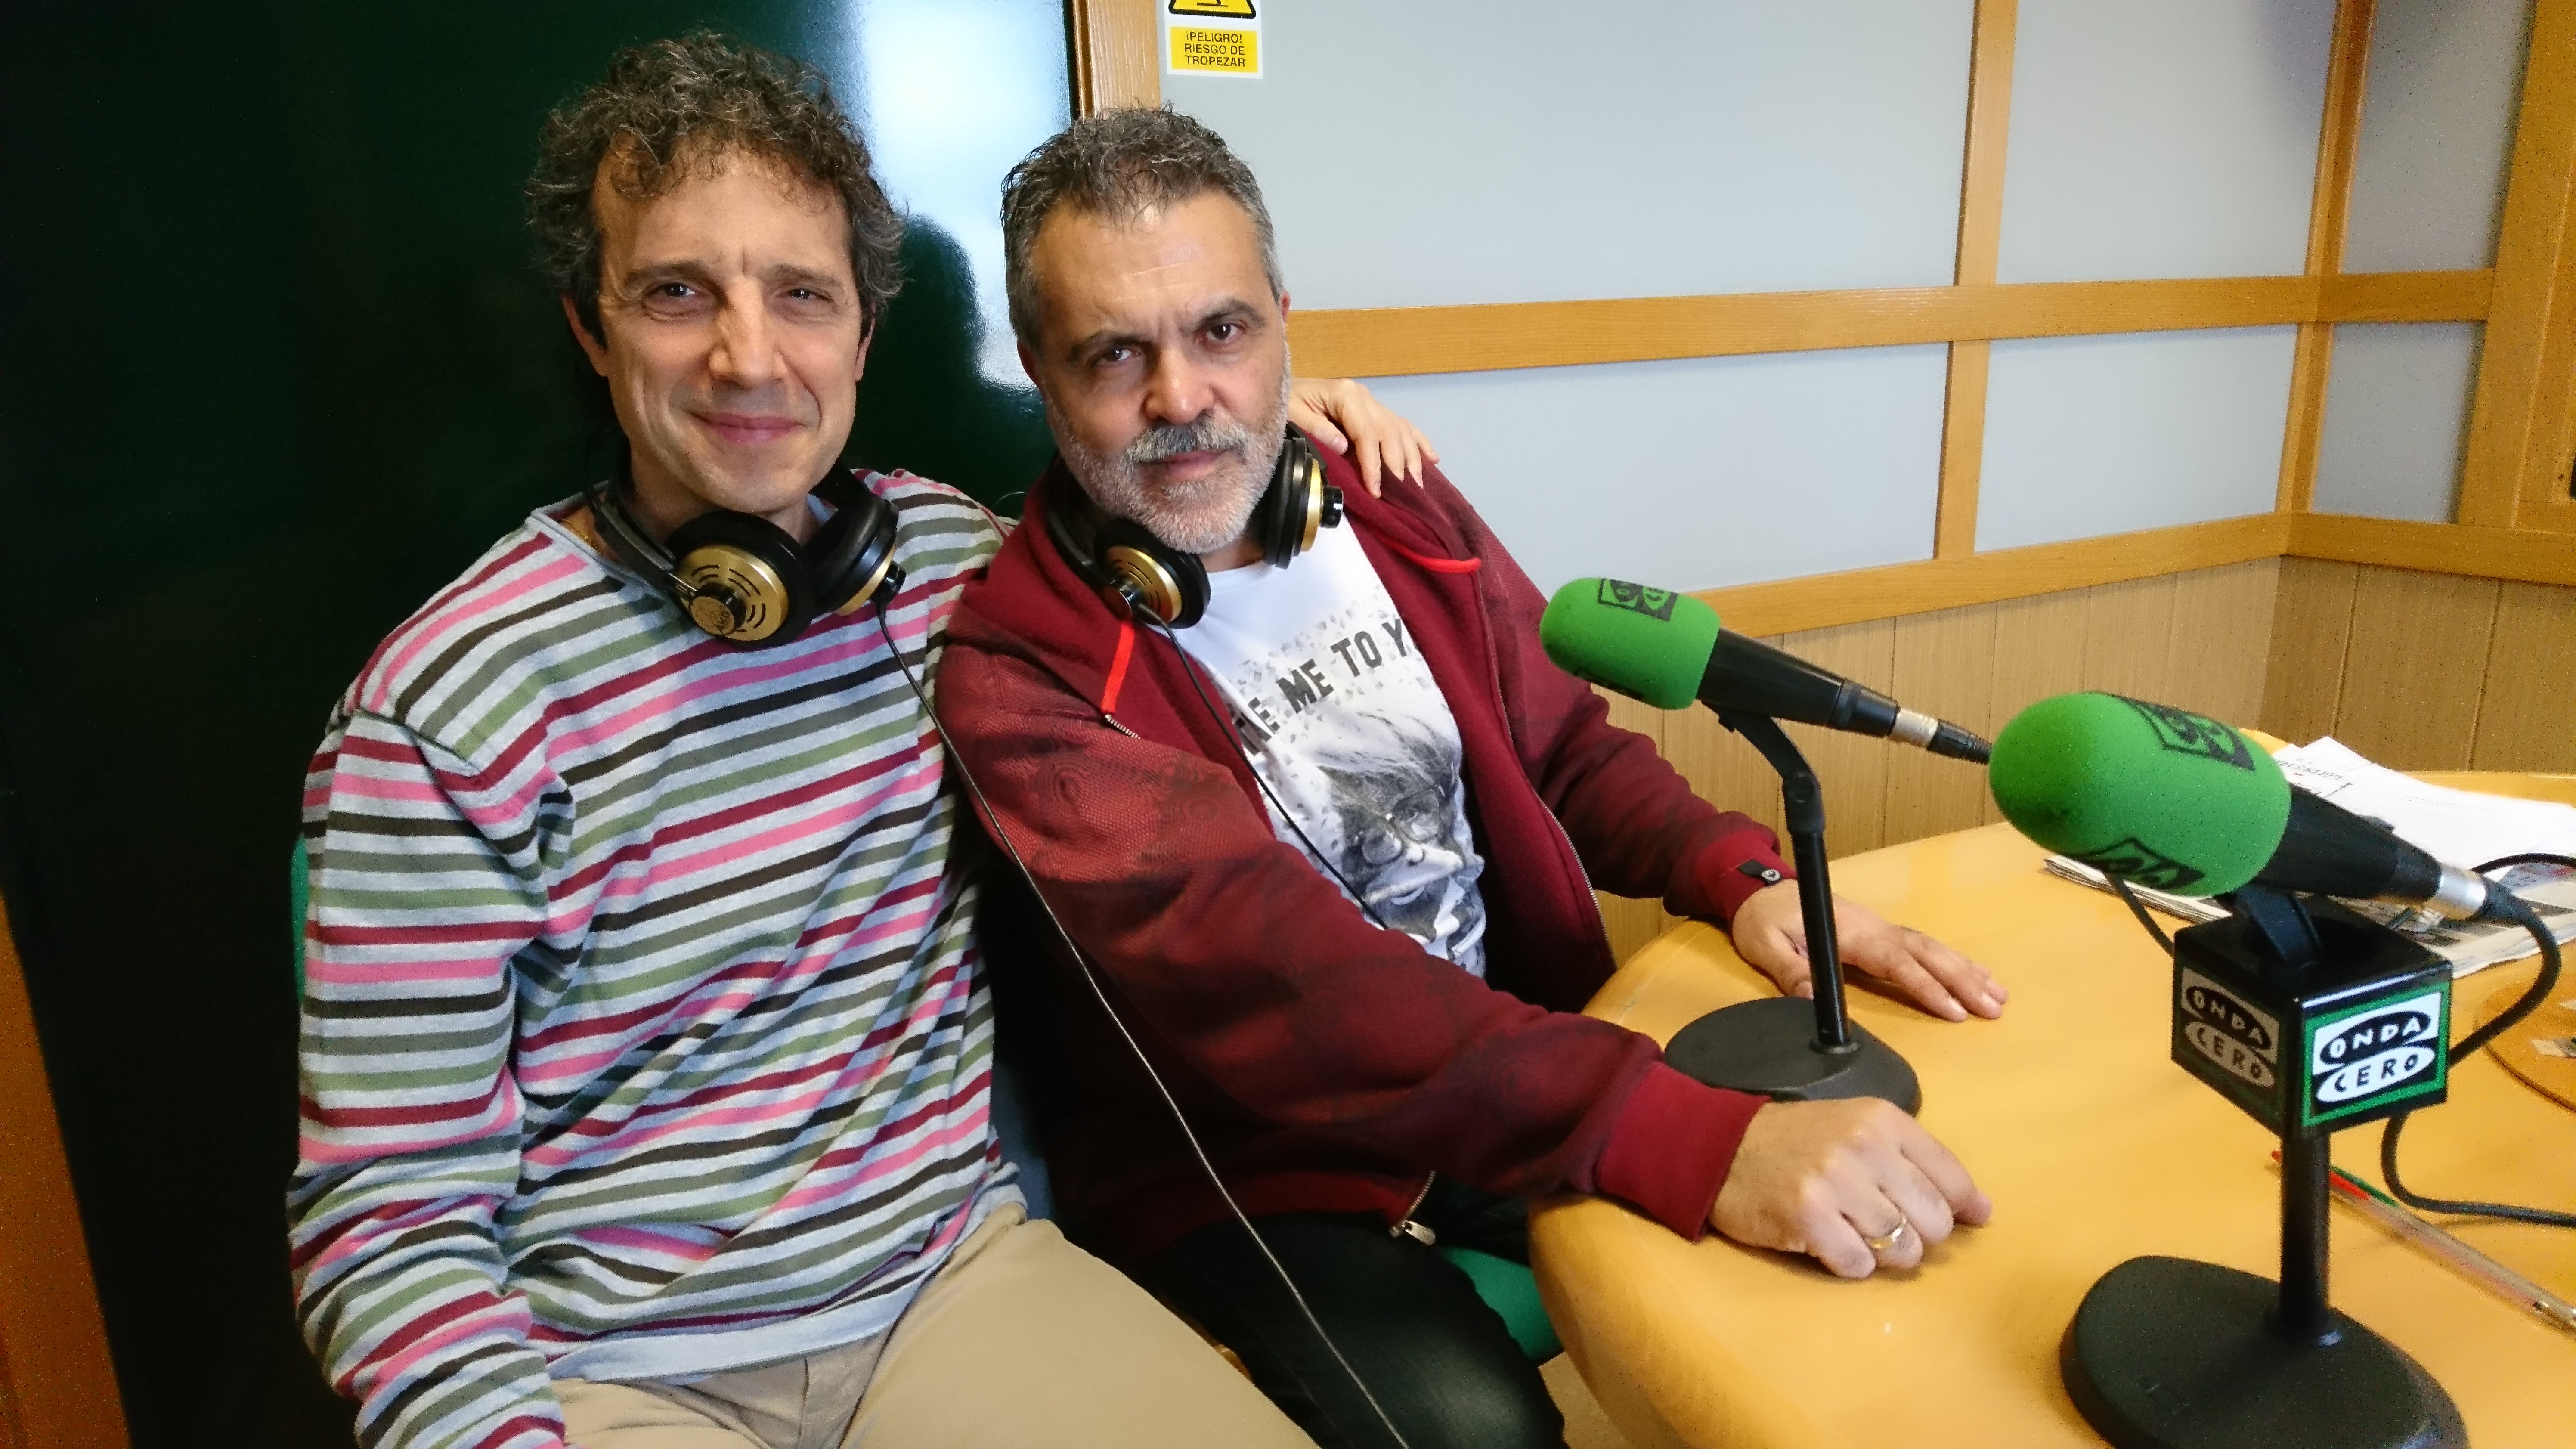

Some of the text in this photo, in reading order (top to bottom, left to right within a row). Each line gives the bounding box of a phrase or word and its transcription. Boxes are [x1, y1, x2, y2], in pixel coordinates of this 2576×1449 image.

[1184, 43, 1245, 55] RIESGO DE
[1186, 31, 1242, 43] ¡PELIGRO!
[1185, 55, 1245, 67] TROPEZAR
[1276, 659, 1334, 714] ME
[1330, 630, 1383, 678] TO
[2192, 989, 2263, 1046] ONDA
[2328, 1016, 2421, 1059] ONDA
[2196, 1026, 2262, 1079] CERO
[2334, 1053, 2419, 1093] CERO
